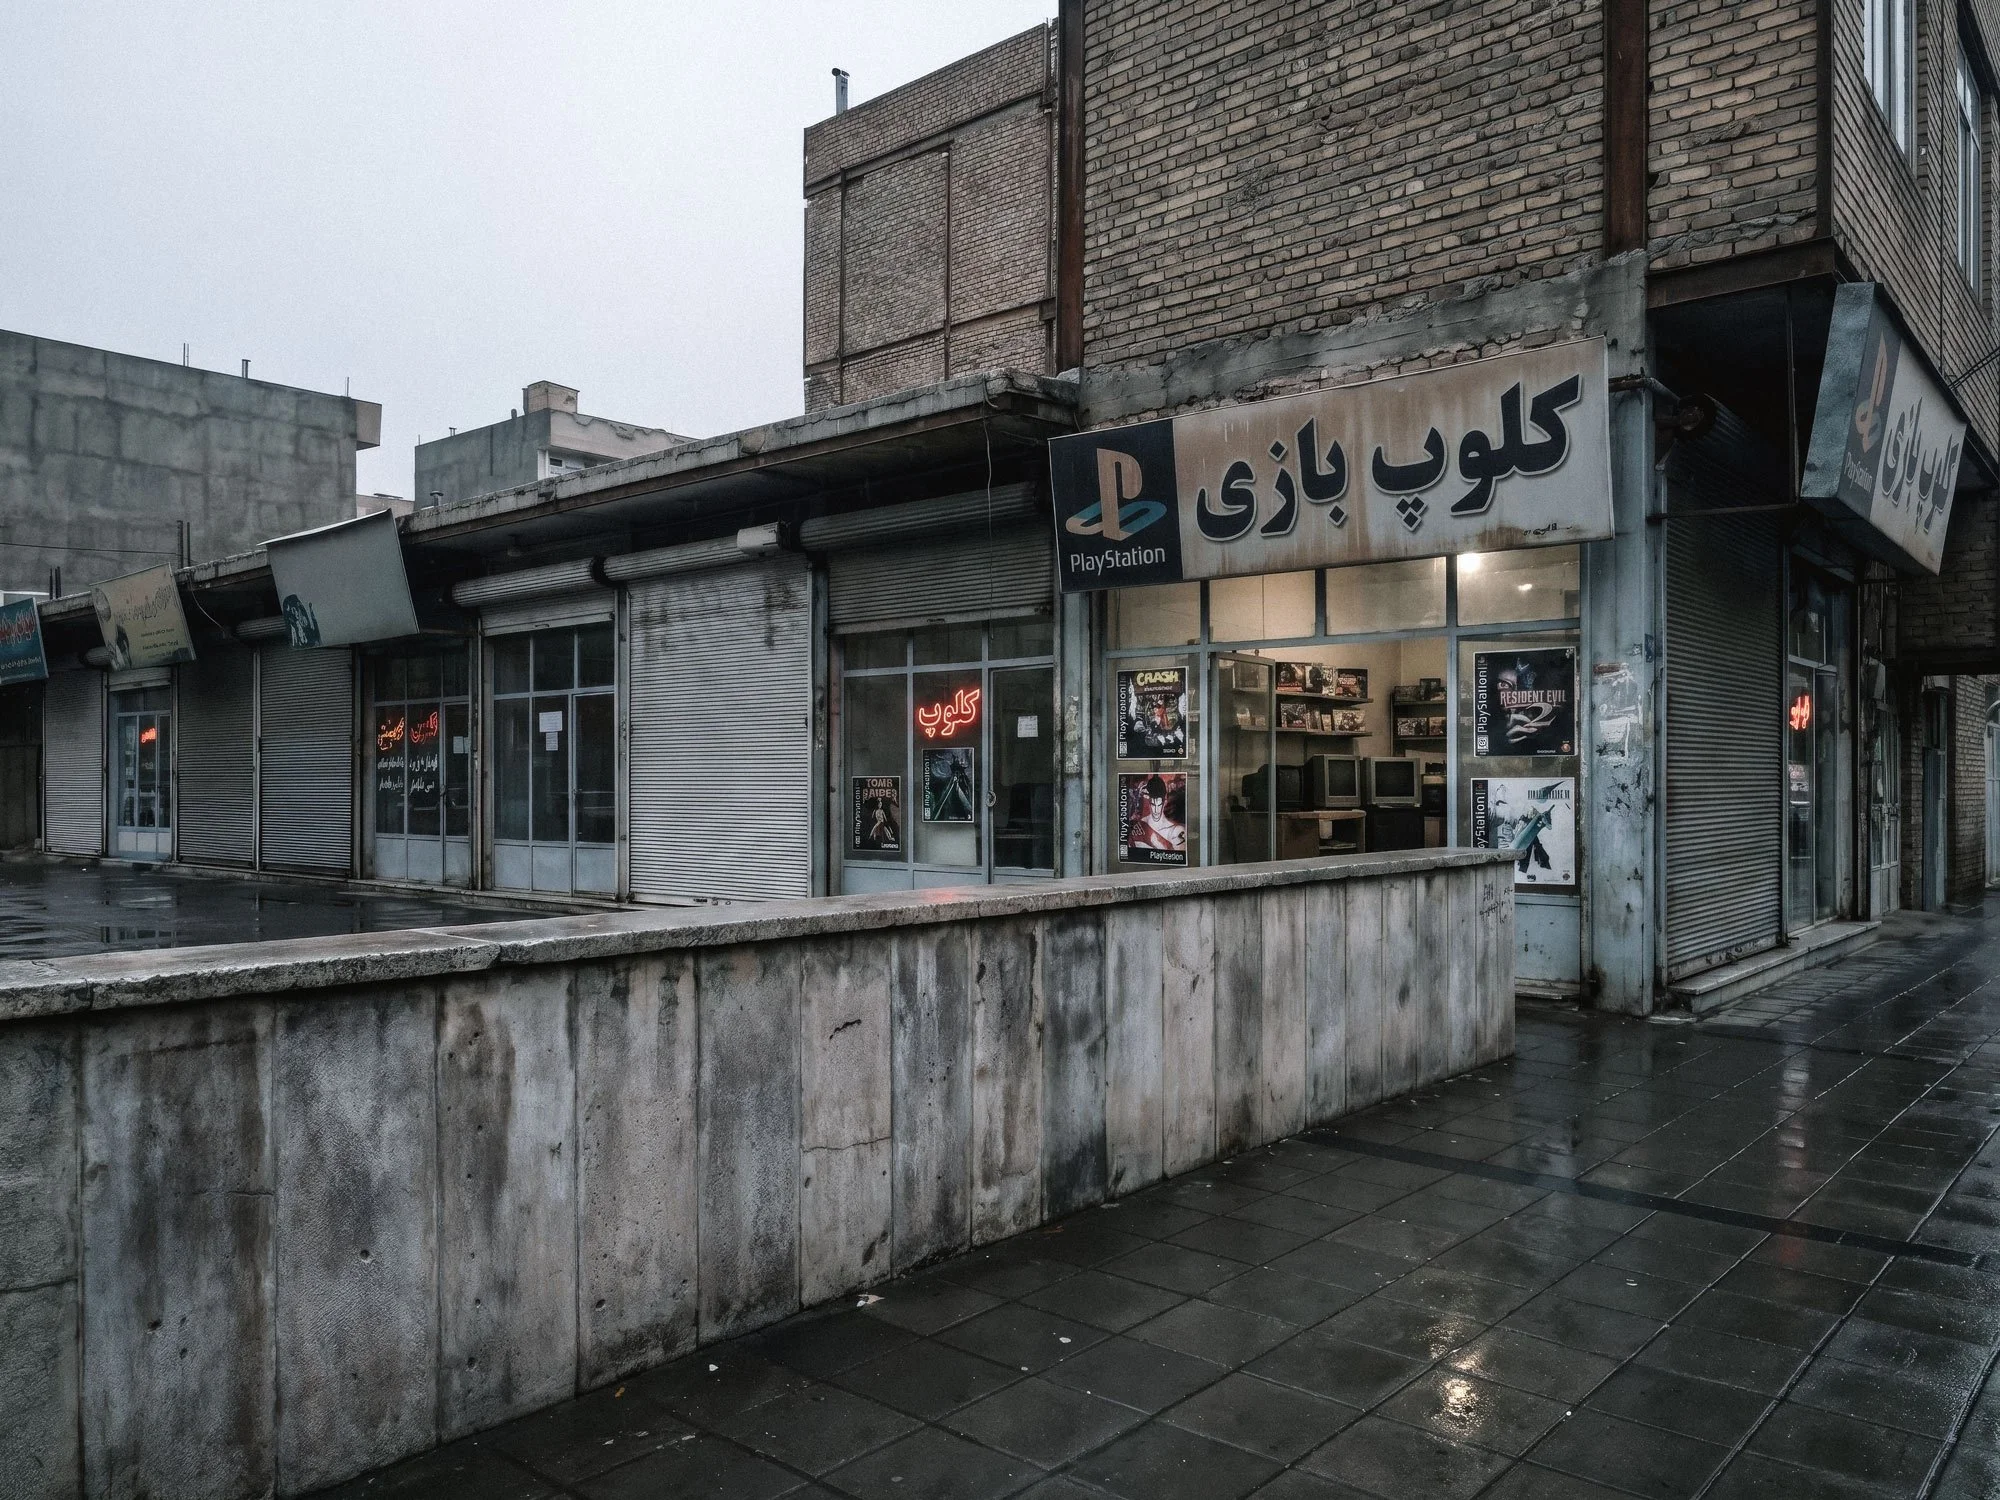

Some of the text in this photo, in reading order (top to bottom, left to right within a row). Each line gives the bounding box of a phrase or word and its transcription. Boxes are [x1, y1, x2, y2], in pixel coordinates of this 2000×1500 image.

[1195, 374, 1582, 542] کلوپ بازی
[1070, 545, 1167, 577] PlayStation
[1500, 690, 1567, 707] RESIDENT EVIL
[1523, 702, 1557, 728] 2
